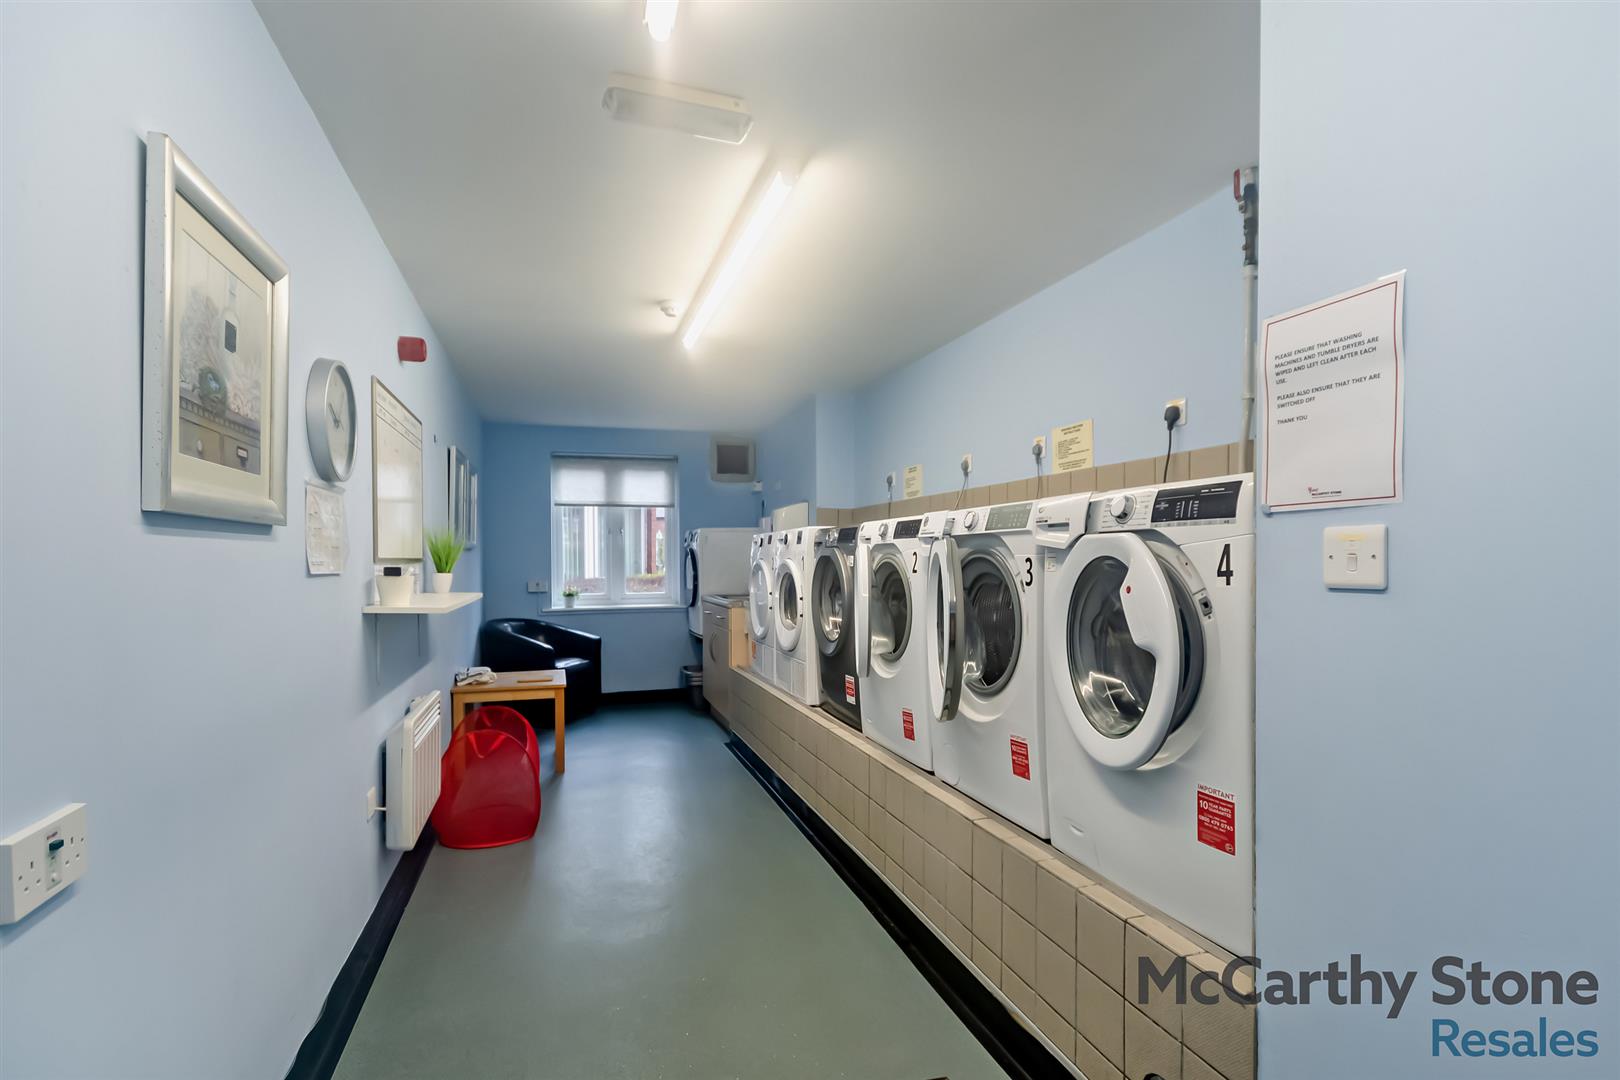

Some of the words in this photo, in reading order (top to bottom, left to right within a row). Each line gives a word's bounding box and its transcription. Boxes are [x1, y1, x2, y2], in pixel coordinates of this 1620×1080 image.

[1275, 351, 1293, 361] PLEASE
[1294, 344, 1315, 355] ENSURE
[1317, 340, 1332, 350] THAT
[1333, 331, 1363, 345] WASHING
[1275, 357, 1302, 369] MACHINES
[1303, 353, 1316, 361] AND
[1317, 346, 1341, 357] TUMBLE
[1342, 340, 1366, 351] DRYERS
[1366, 336, 1380, 345] ARE
[1275, 368, 1293, 377] WIPED
[1293, 364, 1306, 373] AND
[1307, 361, 1319, 369] LEFT
[1320, 356, 1339, 365] CLEAN
[1339, 350, 1358, 360] AFTER
[1360, 346, 1377, 356] EACH
[1277, 392, 1295, 401] PLEASE
[1296, 388, 1310, 396] ALSO
[1311, 384, 1333, 393] ENSURE
[1335, 379, 1350, 388] THAT
[1352, 375, 1367, 384] THEY
[1368, 373, 1381, 381] ARE
[1277, 398, 1305, 409] SWITCHED
[1277, 417, 1295, 425] THANK
[912, 551, 918, 574] 2
[1025, 557, 1034, 587] 3
[1216, 543, 1234, 586] 4
[1197, 783, 1235, 801] IMPORTANT
[1199, 799, 1209, 810] 10
